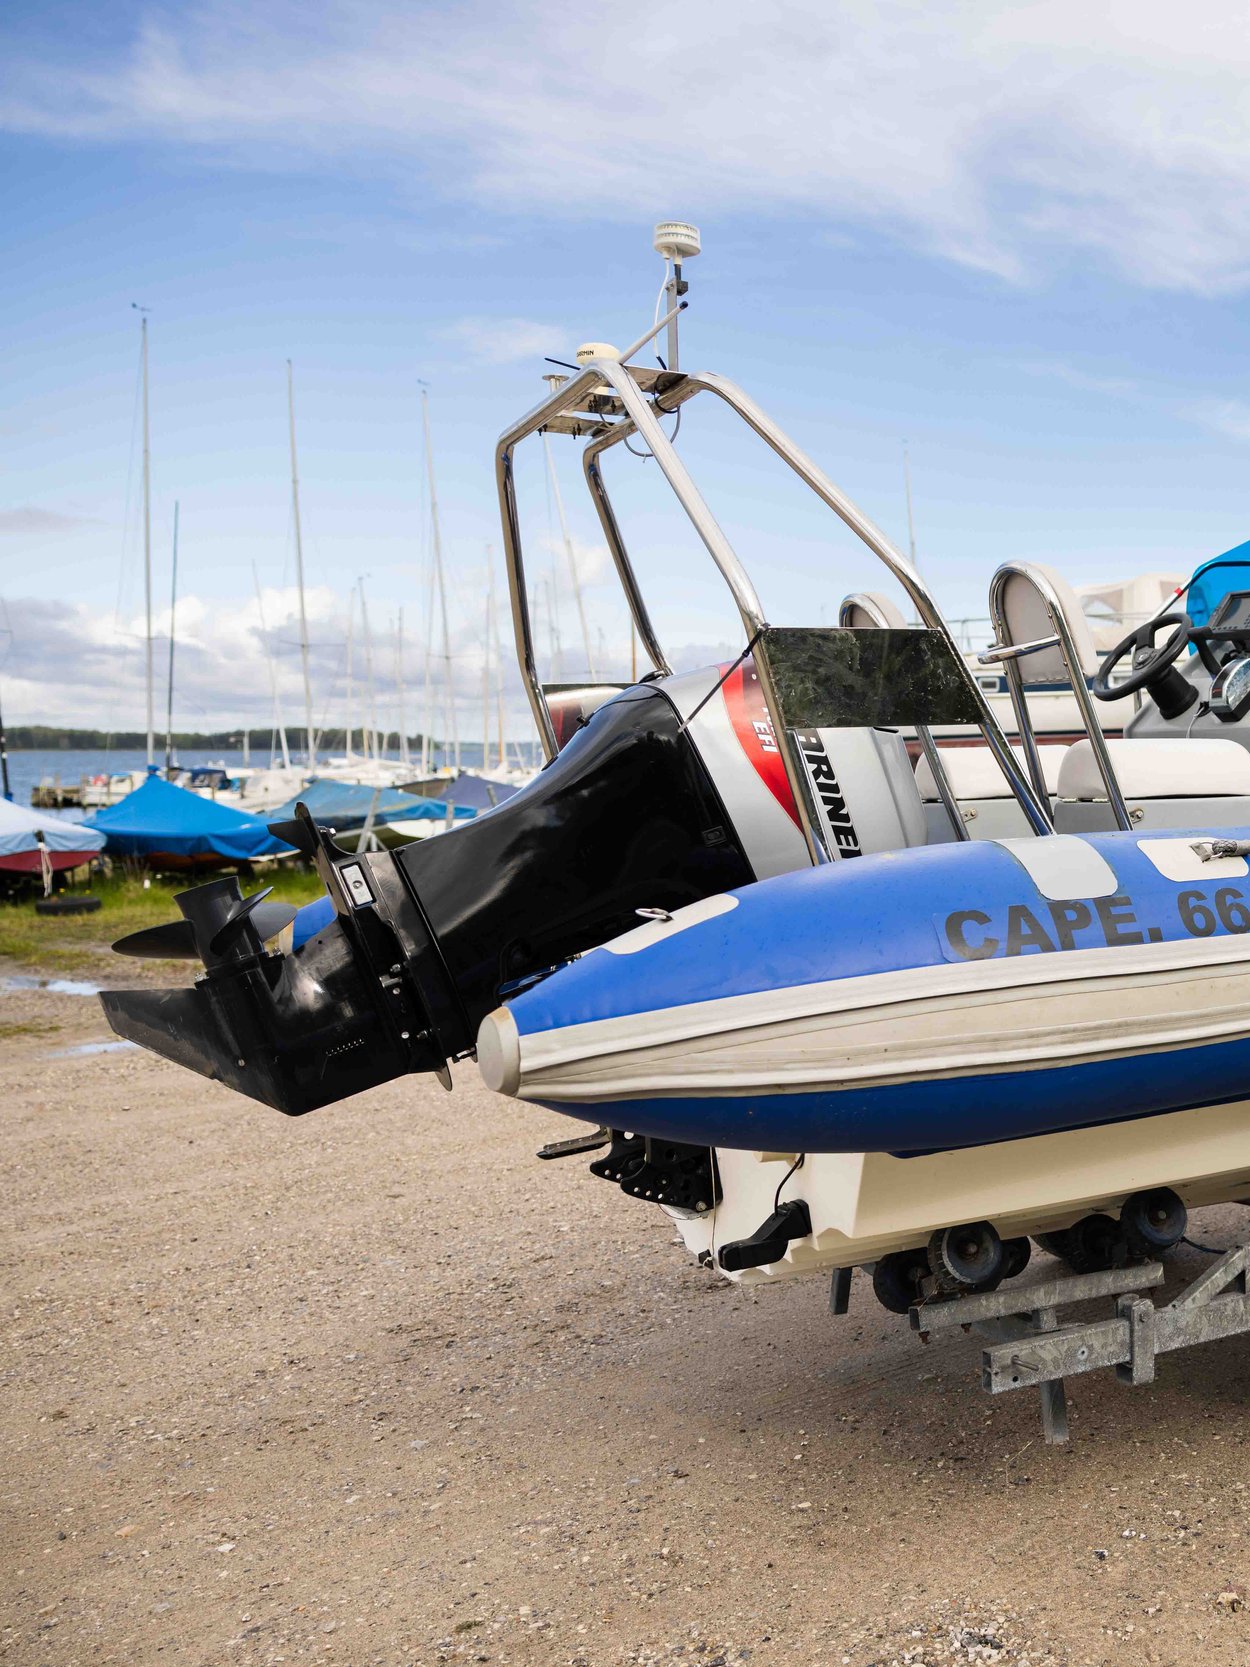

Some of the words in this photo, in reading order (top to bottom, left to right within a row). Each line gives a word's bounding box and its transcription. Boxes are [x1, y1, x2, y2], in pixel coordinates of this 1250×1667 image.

[752, 721, 778, 752] EFI
[797, 728, 863, 859] ARINE
[945, 896, 1163, 960] CAPE.
